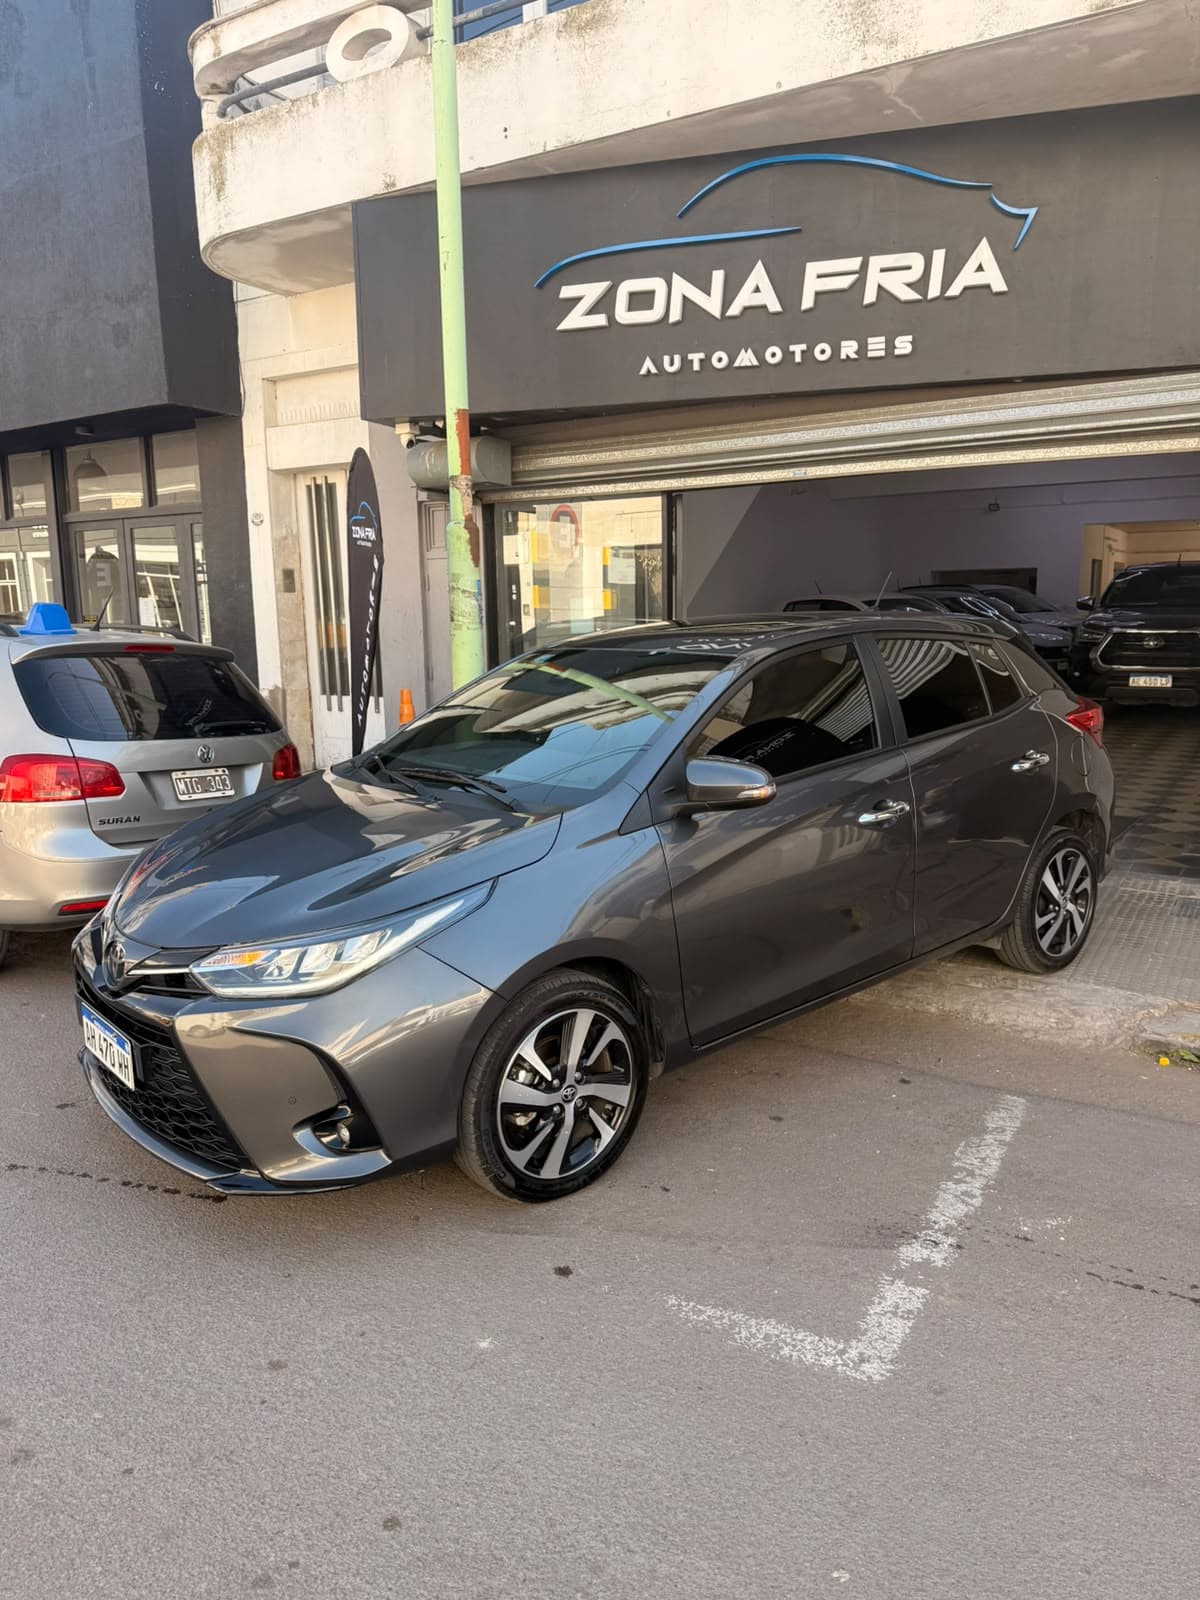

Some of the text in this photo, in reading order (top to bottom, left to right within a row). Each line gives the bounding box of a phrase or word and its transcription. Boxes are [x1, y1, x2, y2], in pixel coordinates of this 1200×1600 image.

[556, 236, 1009, 331] ZONA FRIA
[638, 334, 913, 376] AUTOMOTORES
[176, 775, 231, 794] MTG 343
[98, 815, 141, 826] SURAN
[86, 1021, 97, 1052] AH
[98, 1033, 115, 1067] 470
